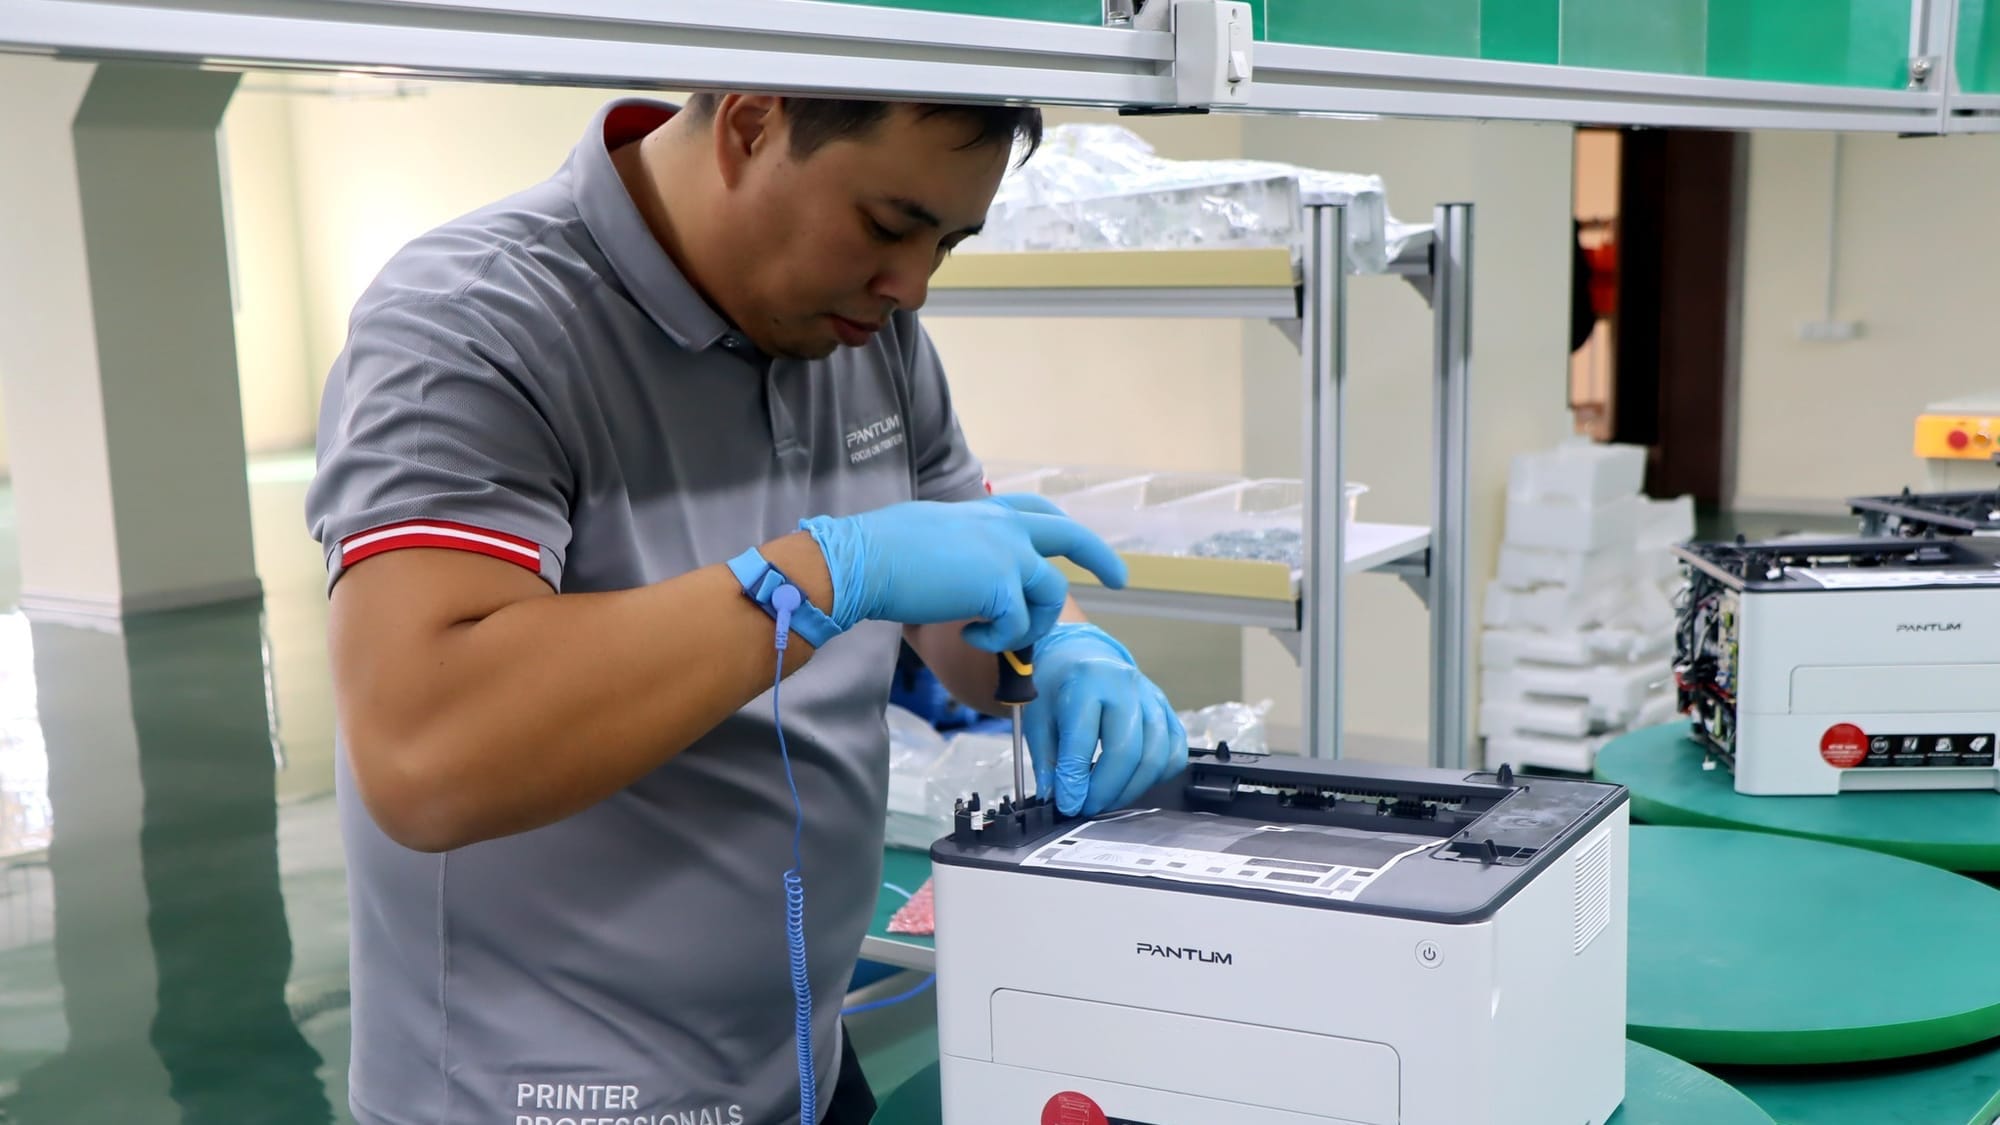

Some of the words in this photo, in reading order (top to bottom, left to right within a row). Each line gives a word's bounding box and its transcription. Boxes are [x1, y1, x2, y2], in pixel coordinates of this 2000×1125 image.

[846, 414, 900, 449] PANTUM
[1896, 623, 1962, 632] PANTUM
[1136, 942, 1232, 965] PANTUM
[516, 1083, 640, 1110] PRINTER
